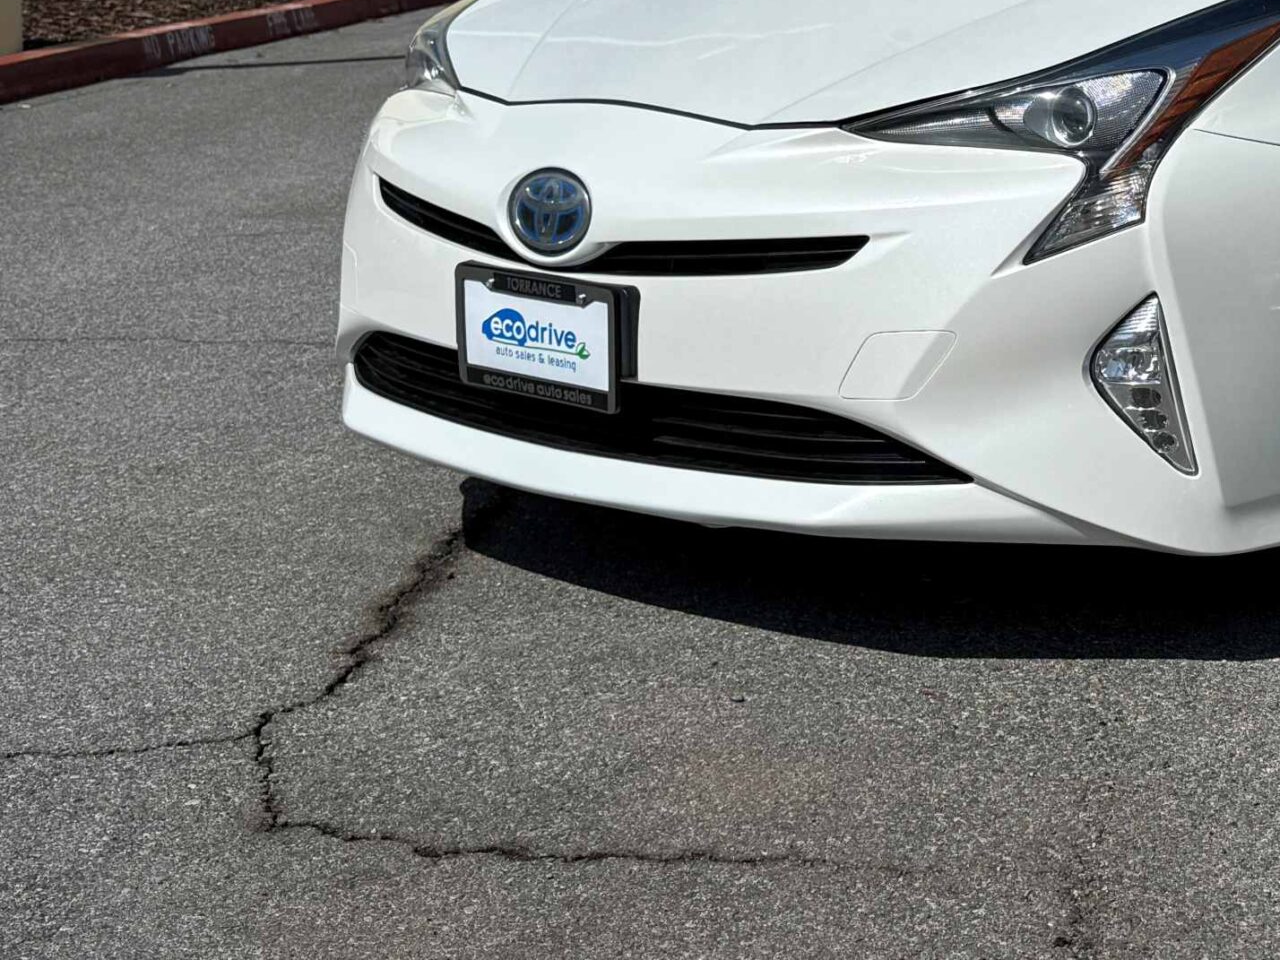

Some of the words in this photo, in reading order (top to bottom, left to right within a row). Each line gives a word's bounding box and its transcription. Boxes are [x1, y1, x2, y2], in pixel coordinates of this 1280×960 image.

[506, 277, 562, 299] TORRANCE
[496, 346, 514, 357] auto
[515, 350, 536, 362] sales
[538, 354, 545, 365] &
[548, 356, 577, 372] leasing
[483, 373, 505, 387] eco
[506, 377, 535, 393] drive
[537, 384, 562, 399] auto
[563, 389, 593, 405] sales
